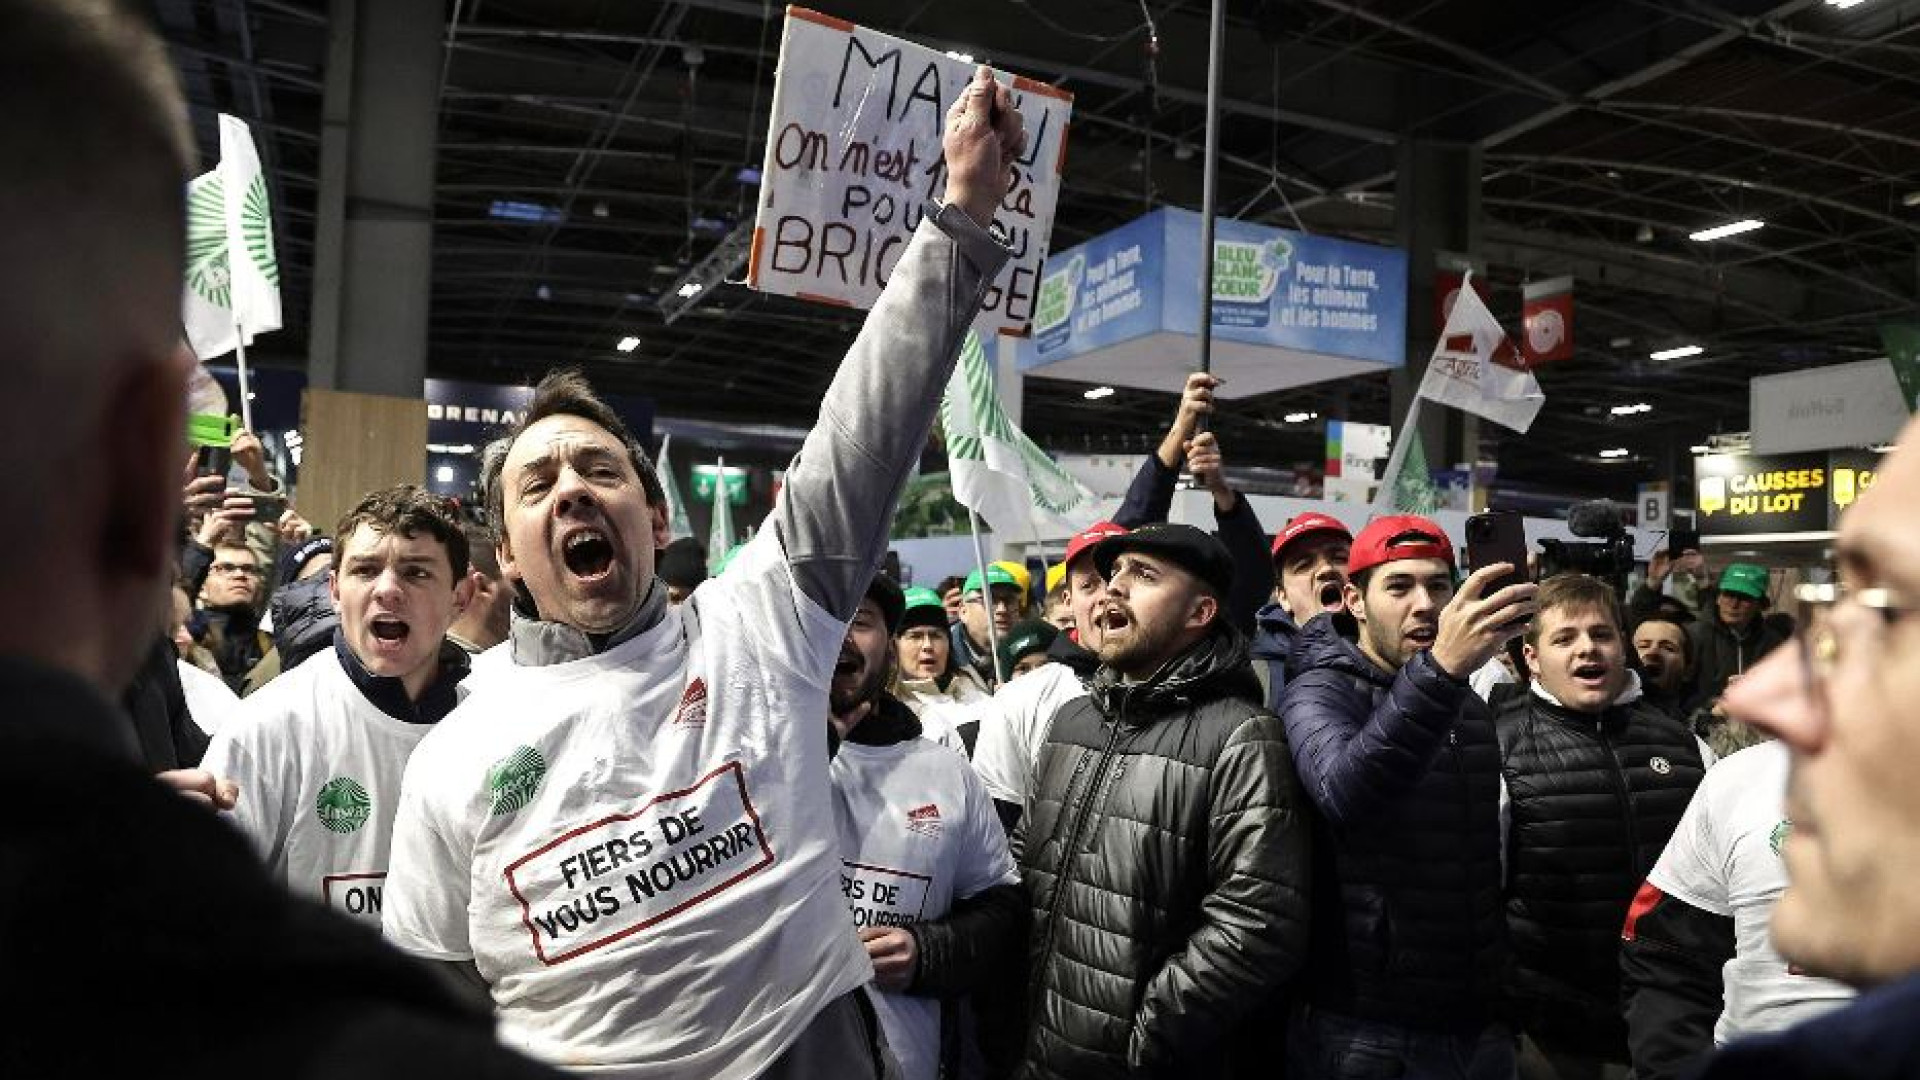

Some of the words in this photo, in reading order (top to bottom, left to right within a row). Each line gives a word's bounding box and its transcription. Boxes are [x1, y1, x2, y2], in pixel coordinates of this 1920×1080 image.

[775, 123, 828, 172] On
[841, 186, 923, 233] POU
[1217, 245, 1256, 261] BLEU
[1296, 261, 1325, 284] Pour
[1289, 282, 1309, 303] les
[1313, 288, 1369, 308] animaux
[1300, 306, 1318, 327] les
[1320, 310, 1377, 330] hommes
[1730, 469, 1824, 493] CAUSSES
[1646, 498, 1659, 520] B
[1730, 495, 1758, 515] DU
[1762, 492, 1804, 512] LOT
[560, 831, 652, 889] FIERS
[658, 806, 705, 846] DE
[534, 886, 620, 938] VOUS
[625, 822, 754, 903] NOURRIR
[345, 887, 381, 914] ON
[872, 882, 900, 906] DE
